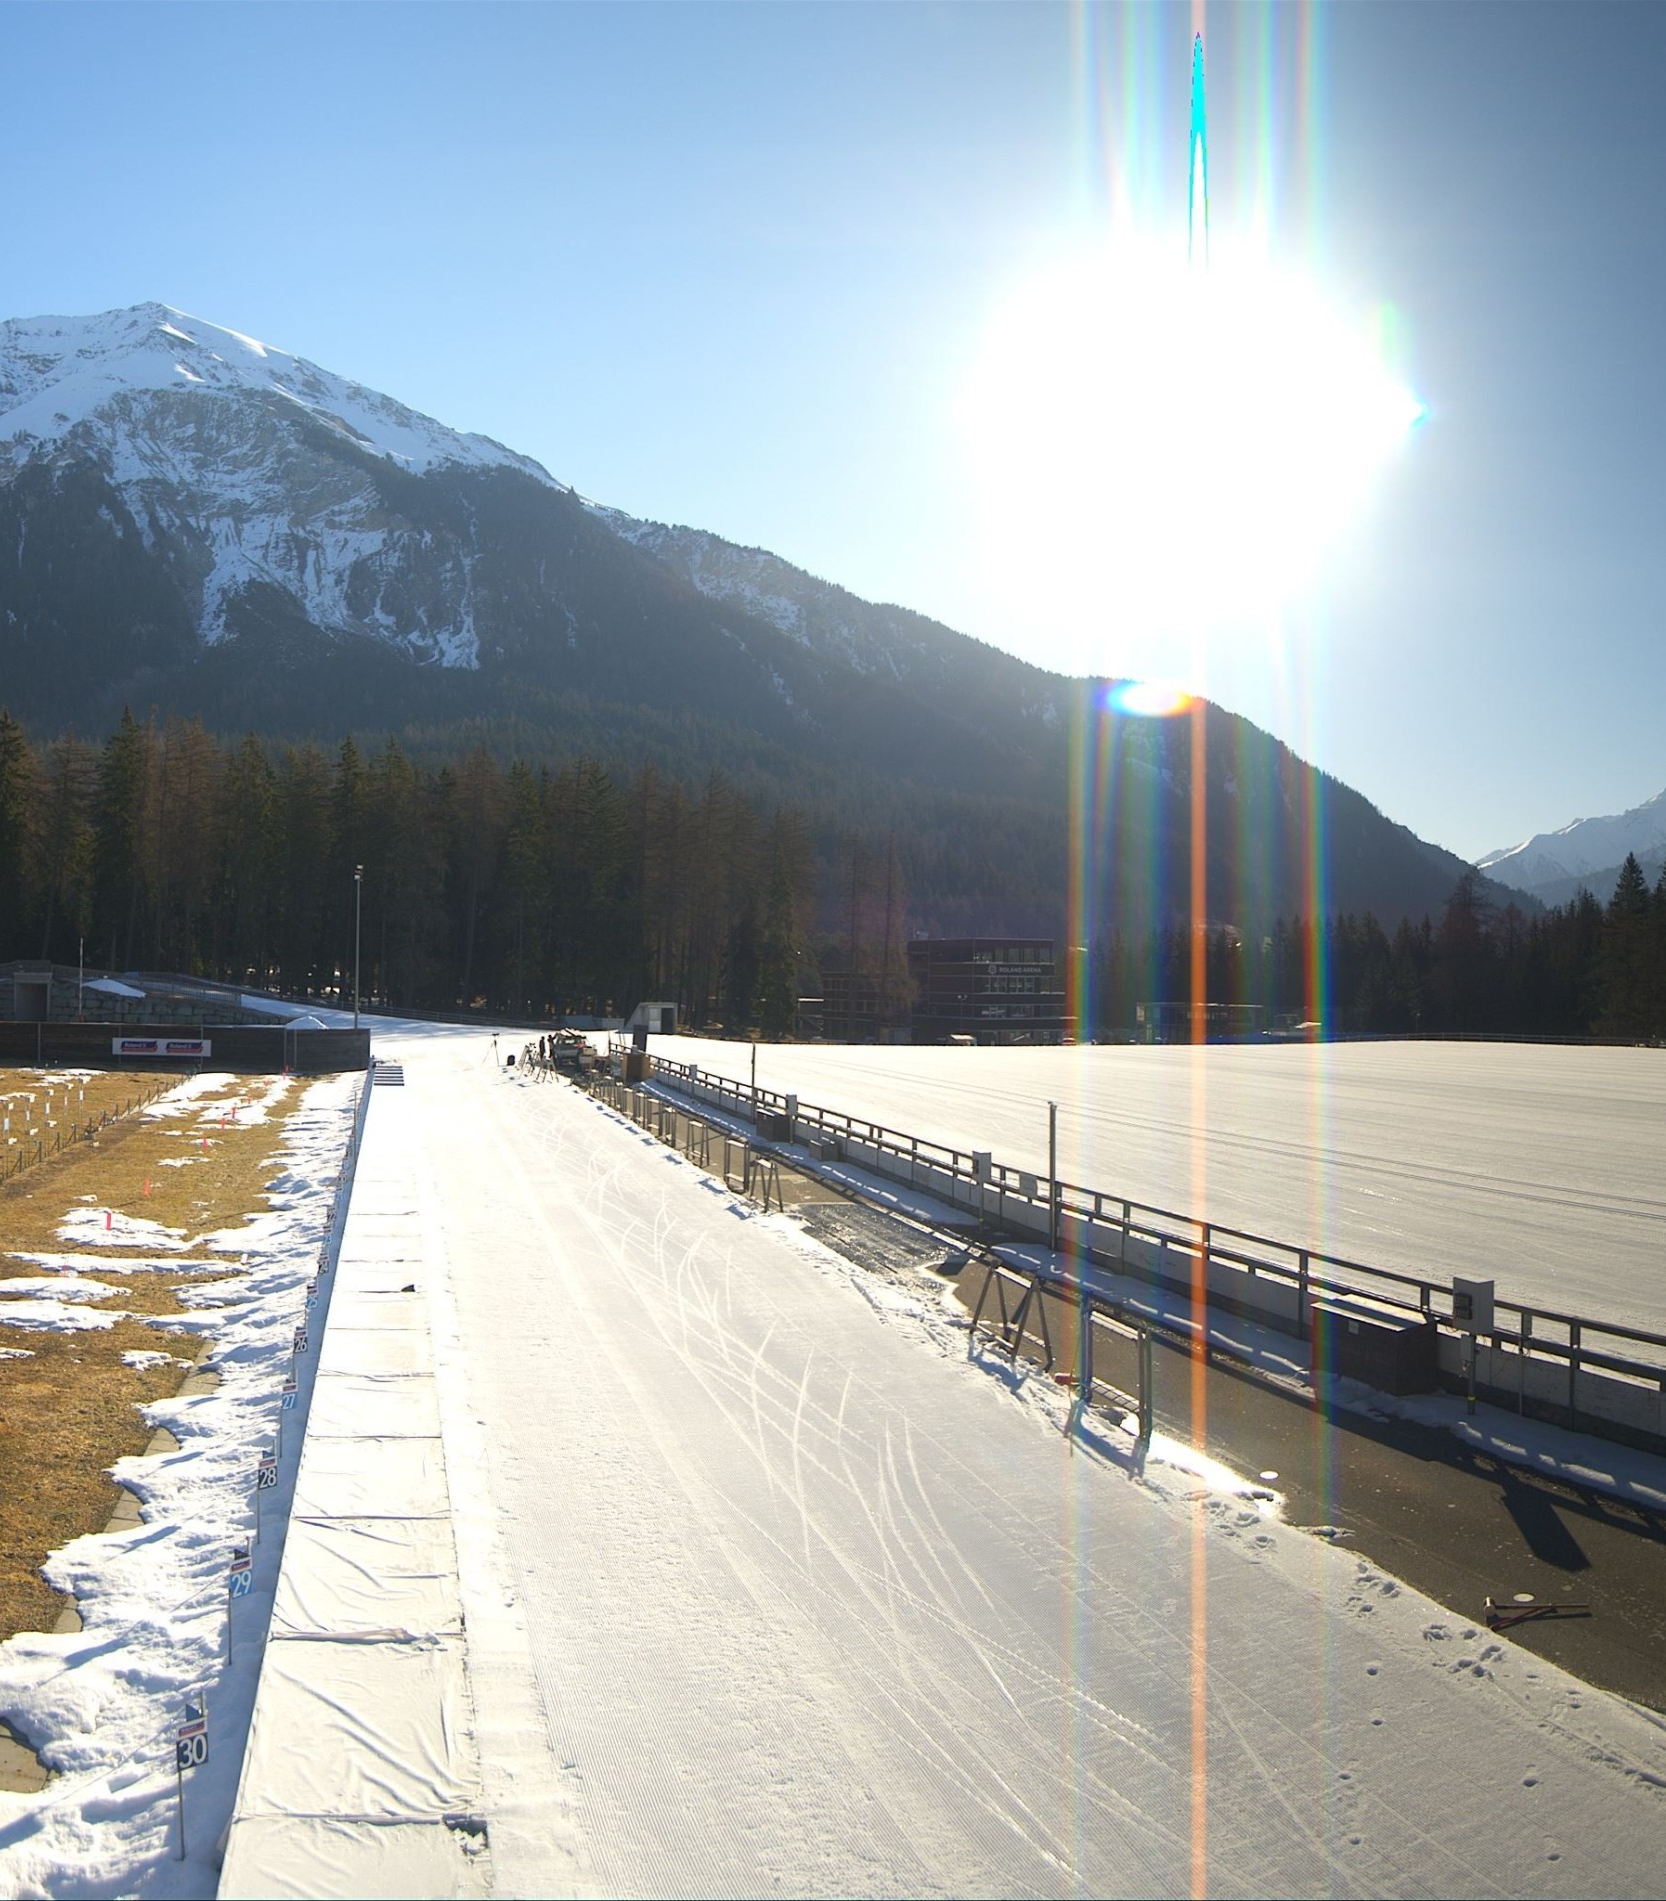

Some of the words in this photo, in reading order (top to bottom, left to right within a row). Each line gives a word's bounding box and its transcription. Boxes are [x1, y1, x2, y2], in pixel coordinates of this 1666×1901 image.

[307, 1296, 318, 1308] 25
[295, 1339, 307, 1352] 26
[283, 1393, 295, 1410] 27
[259, 1467, 277, 1489] 28
[231, 1570, 252, 1597] 29
[179, 1734, 207, 1769] 30
